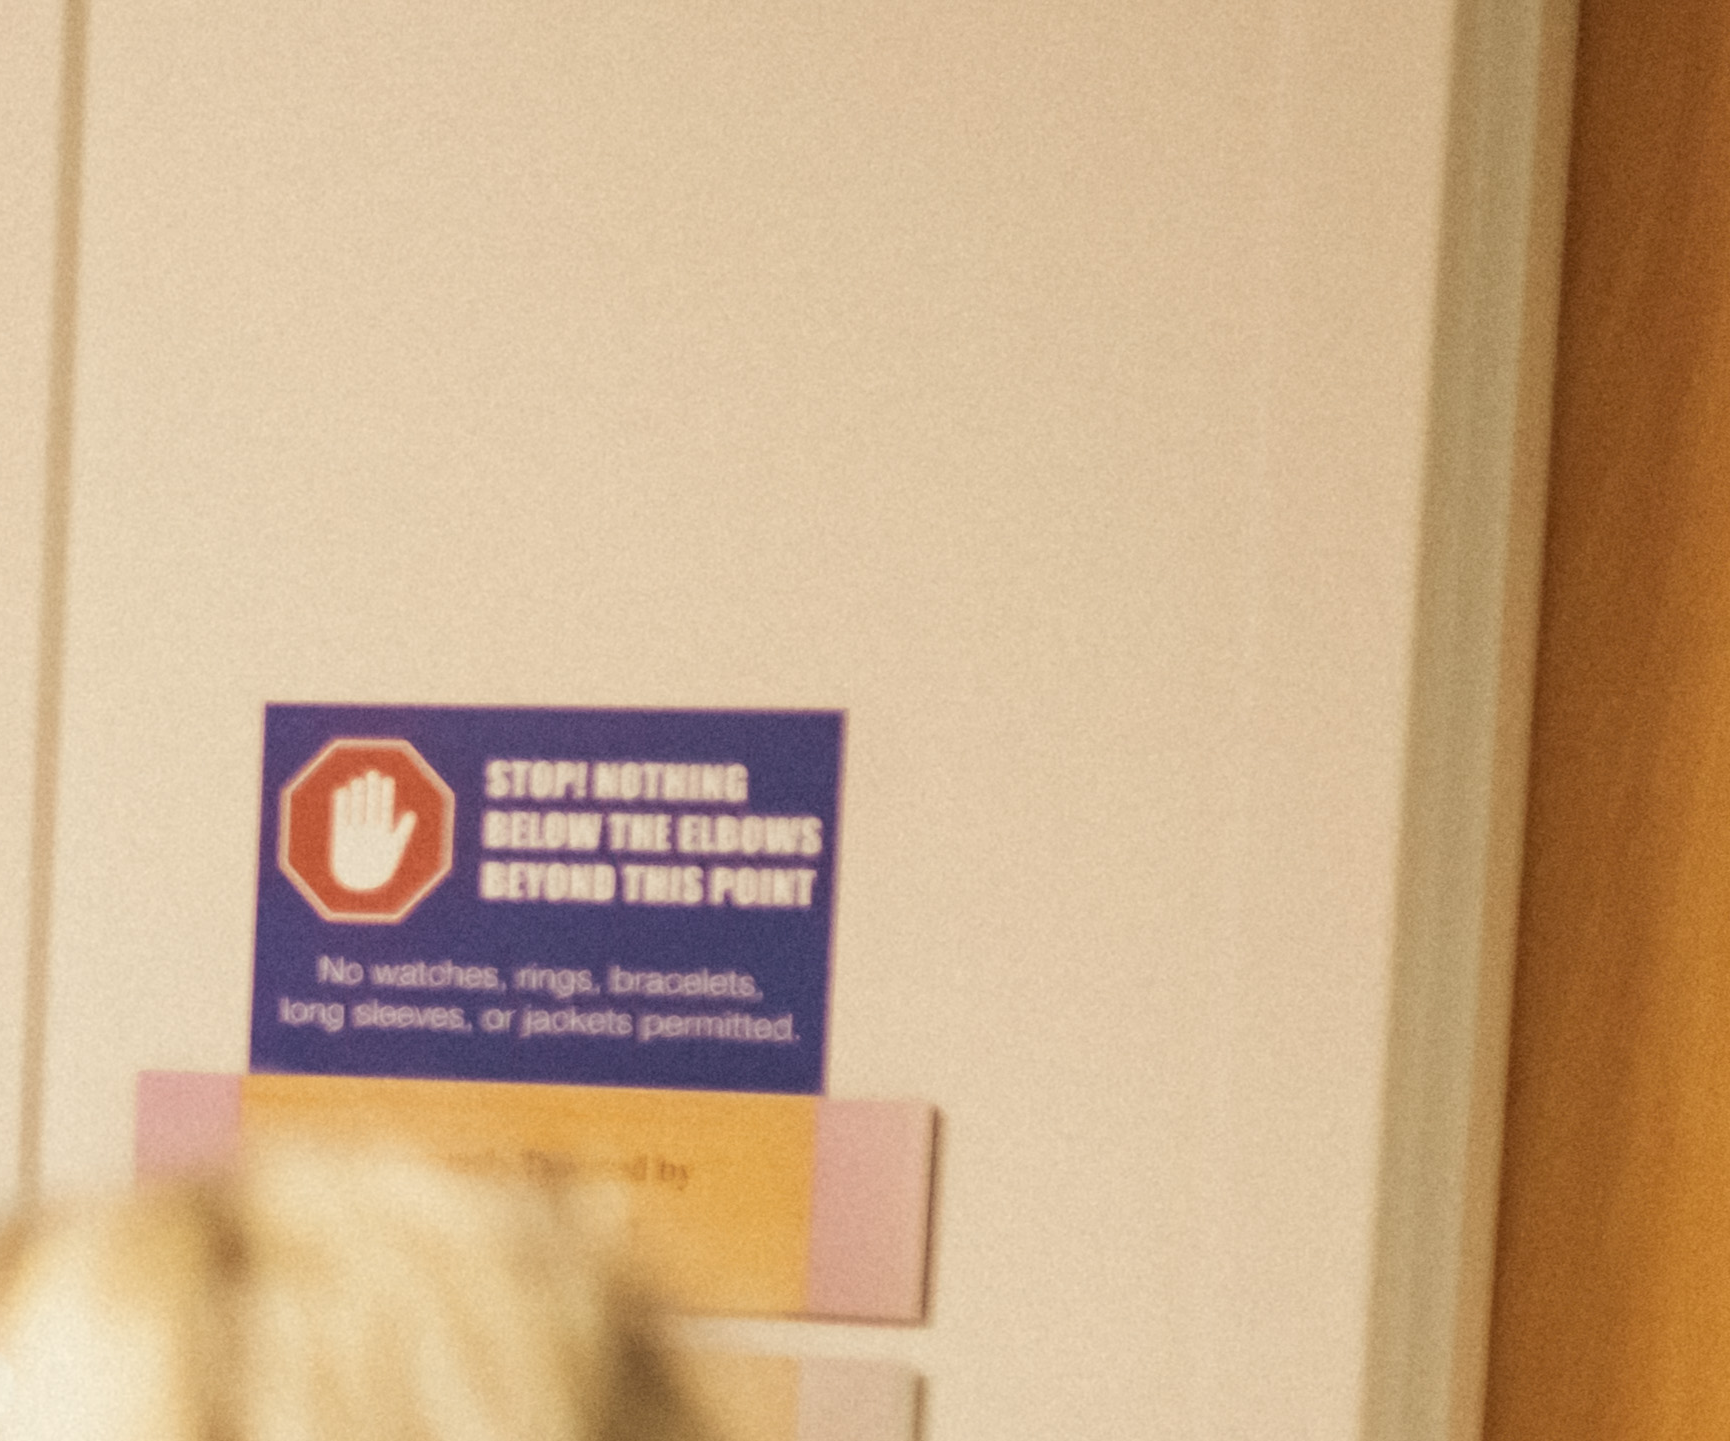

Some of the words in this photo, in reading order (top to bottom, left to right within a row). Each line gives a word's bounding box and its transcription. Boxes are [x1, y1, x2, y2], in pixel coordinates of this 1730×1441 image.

[485, 758, 589, 800] STOP!
[593, 761, 750, 804] NOTHING
[481, 809, 604, 852] BELOW
[609, 811, 674, 853] THE
[677, 813, 824, 857] ELBOWS
[478, 859, 617, 903] BEYOND
[620, 863, 706, 905] THIS
[710, 866, 819, 909] POINT
[317, 954, 365, 986] No
[370, 958, 507, 992] watches,
[512, 961, 601, 999] rings,
[607, 964, 765, 1001] bracelets,
[277, 996, 346, 1033] long
[351, 999, 472, 1033] sleeves,
[480, 1006, 516, 1032] or
[518, 1005, 634, 1040] jackets
[637, 1011, 801, 1043] permitted.
